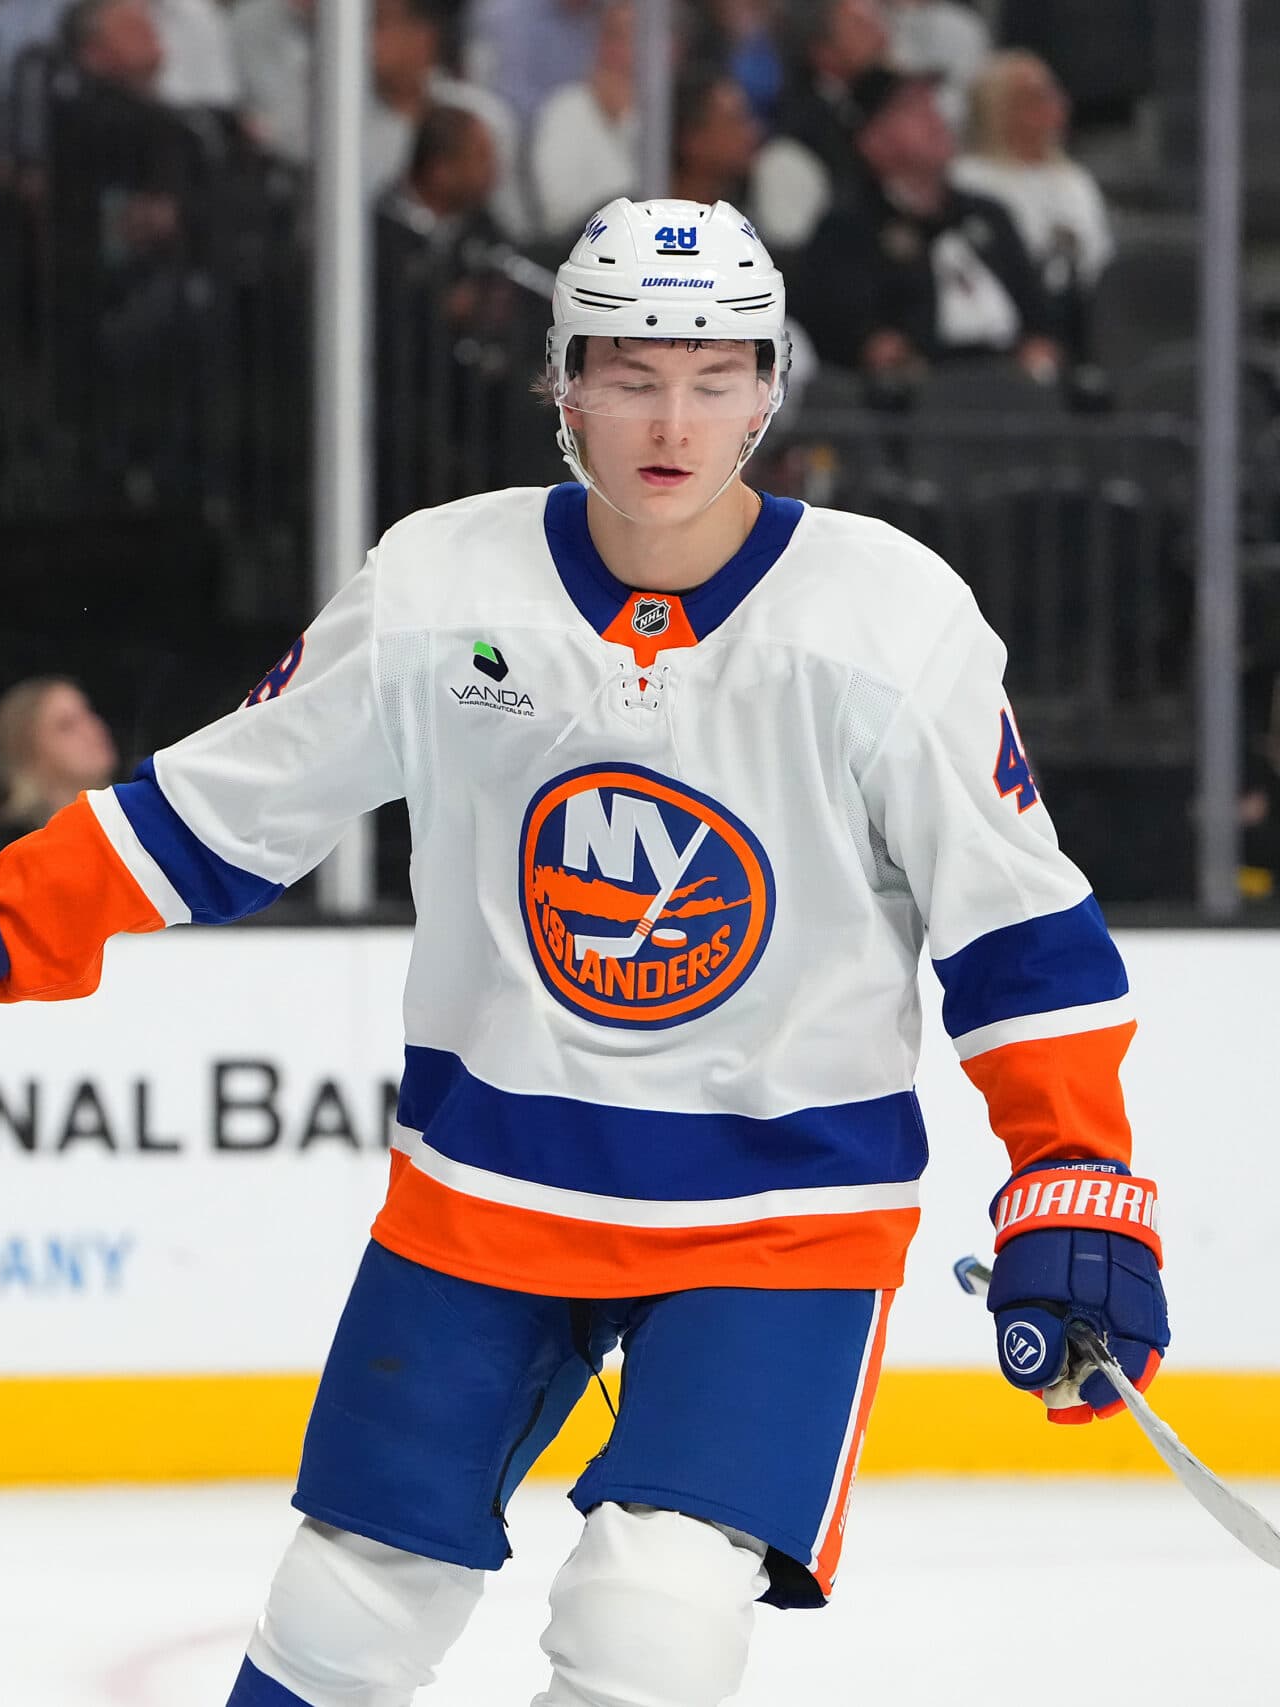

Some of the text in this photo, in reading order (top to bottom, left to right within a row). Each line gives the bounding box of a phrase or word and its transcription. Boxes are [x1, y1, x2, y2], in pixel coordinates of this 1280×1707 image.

[640, 277, 715, 290] WARRIOR
[638, 608, 664, 628] NHL
[245, 631, 306, 708] 8
[449, 685, 535, 710] VANDA
[459, 700, 522, 715] PHARMACEUTICALS
[992, 707, 1038, 815] 4
[563, 786, 711, 902] NY
[541, 903, 731, 1001] ISLANDERS
[206, 1057, 400, 1154] BA
[995, 1179, 1161, 1235] WARRI
